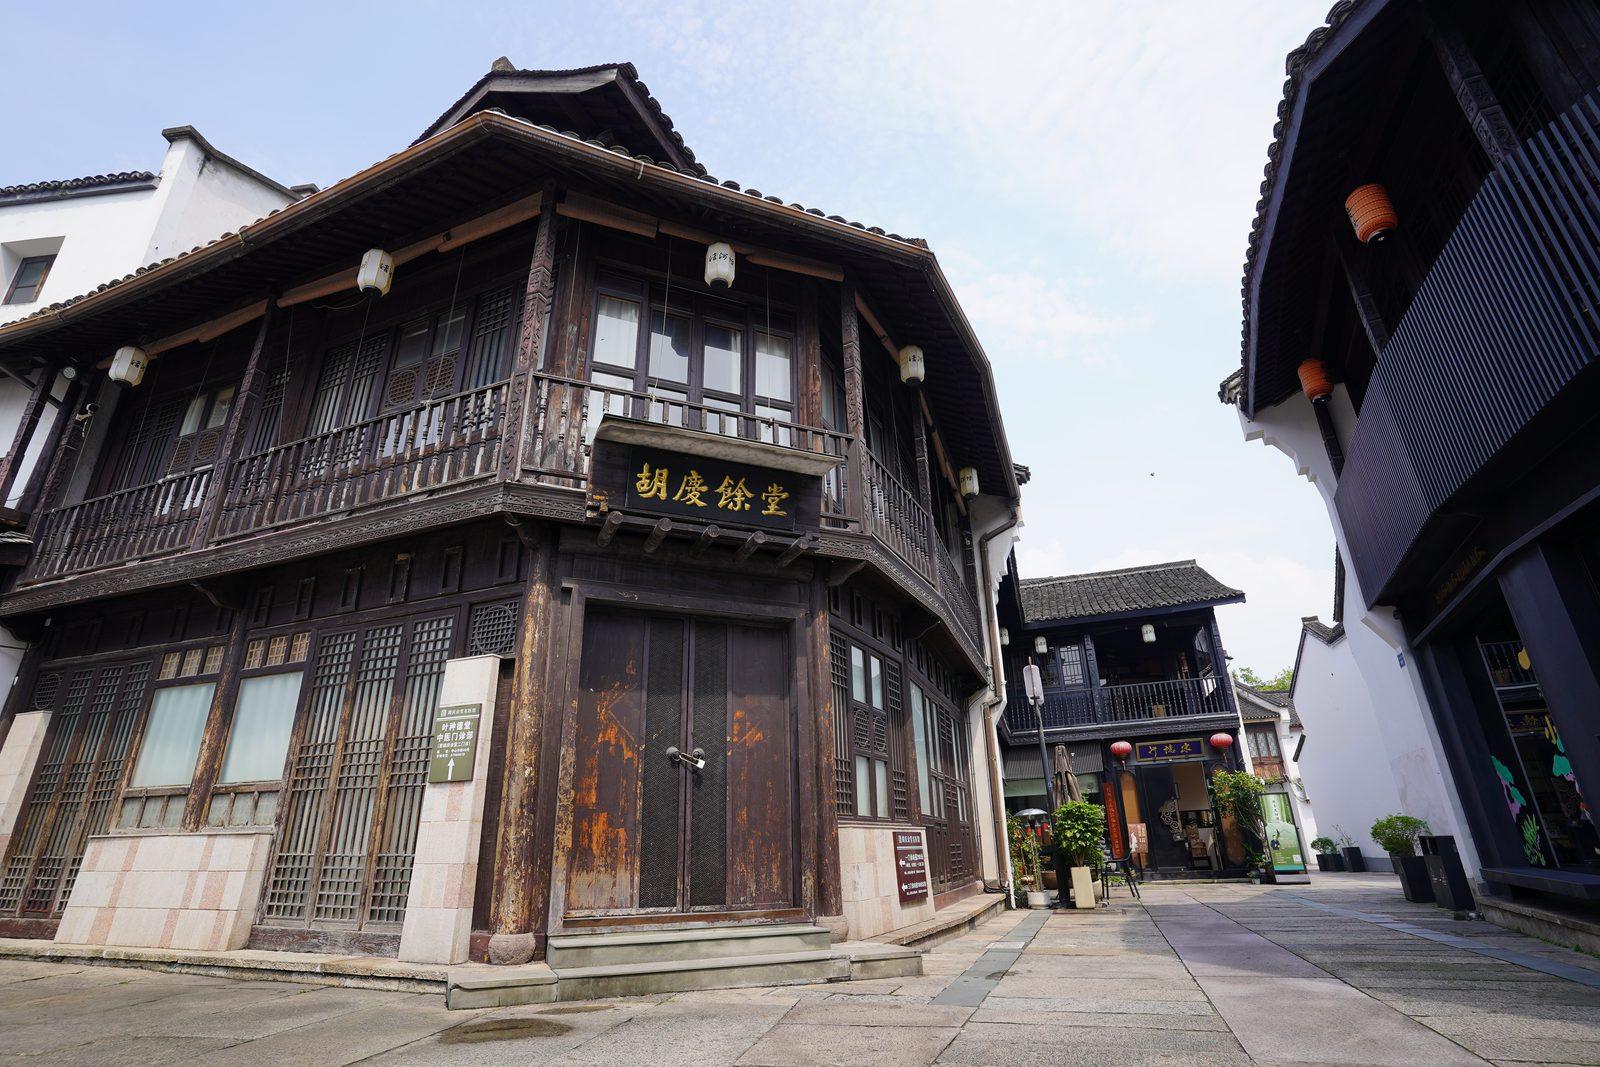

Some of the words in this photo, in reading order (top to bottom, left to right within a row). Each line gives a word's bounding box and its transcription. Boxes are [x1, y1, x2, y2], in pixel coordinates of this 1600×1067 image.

[635, 462, 791, 517] 胡慶餘堂
[436, 731, 474, 742] 中医门诊部
